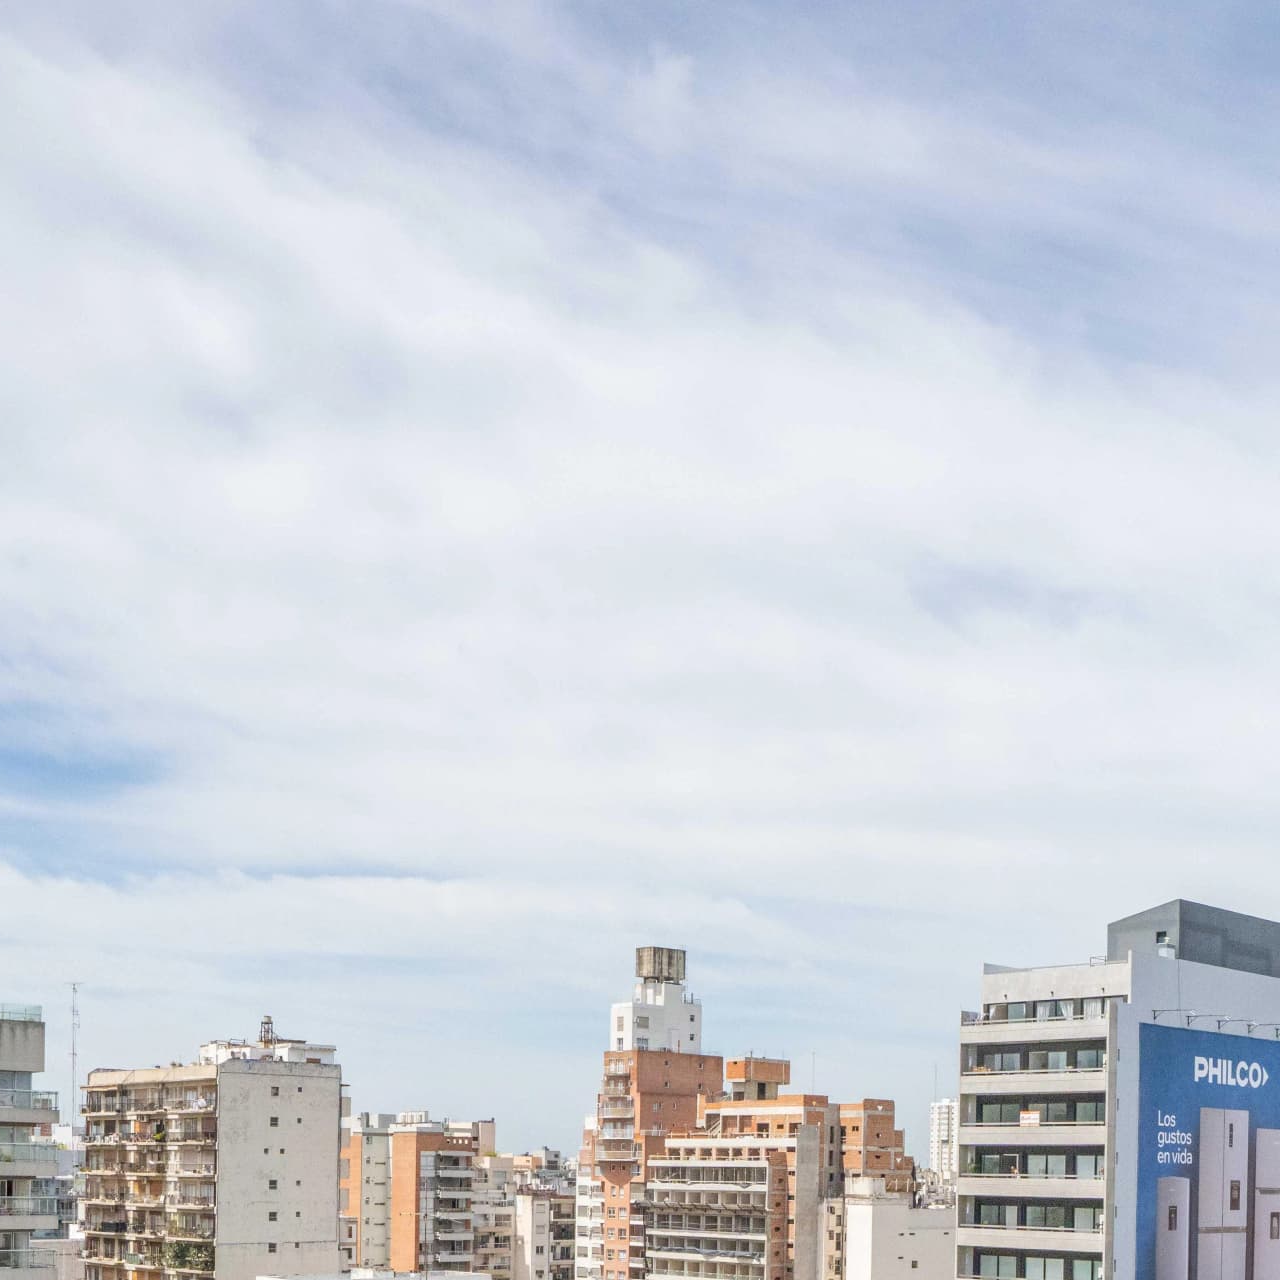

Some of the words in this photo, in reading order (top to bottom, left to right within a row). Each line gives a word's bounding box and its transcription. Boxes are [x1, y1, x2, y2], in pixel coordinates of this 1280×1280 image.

[1194, 1056, 1262, 1088] PHILCO
[1157, 1110, 1176, 1127] Los
[1157, 1130, 1192, 1148] gustos
[1157, 1151, 1170, 1163] en
[1172, 1147, 1193, 1164] vida
